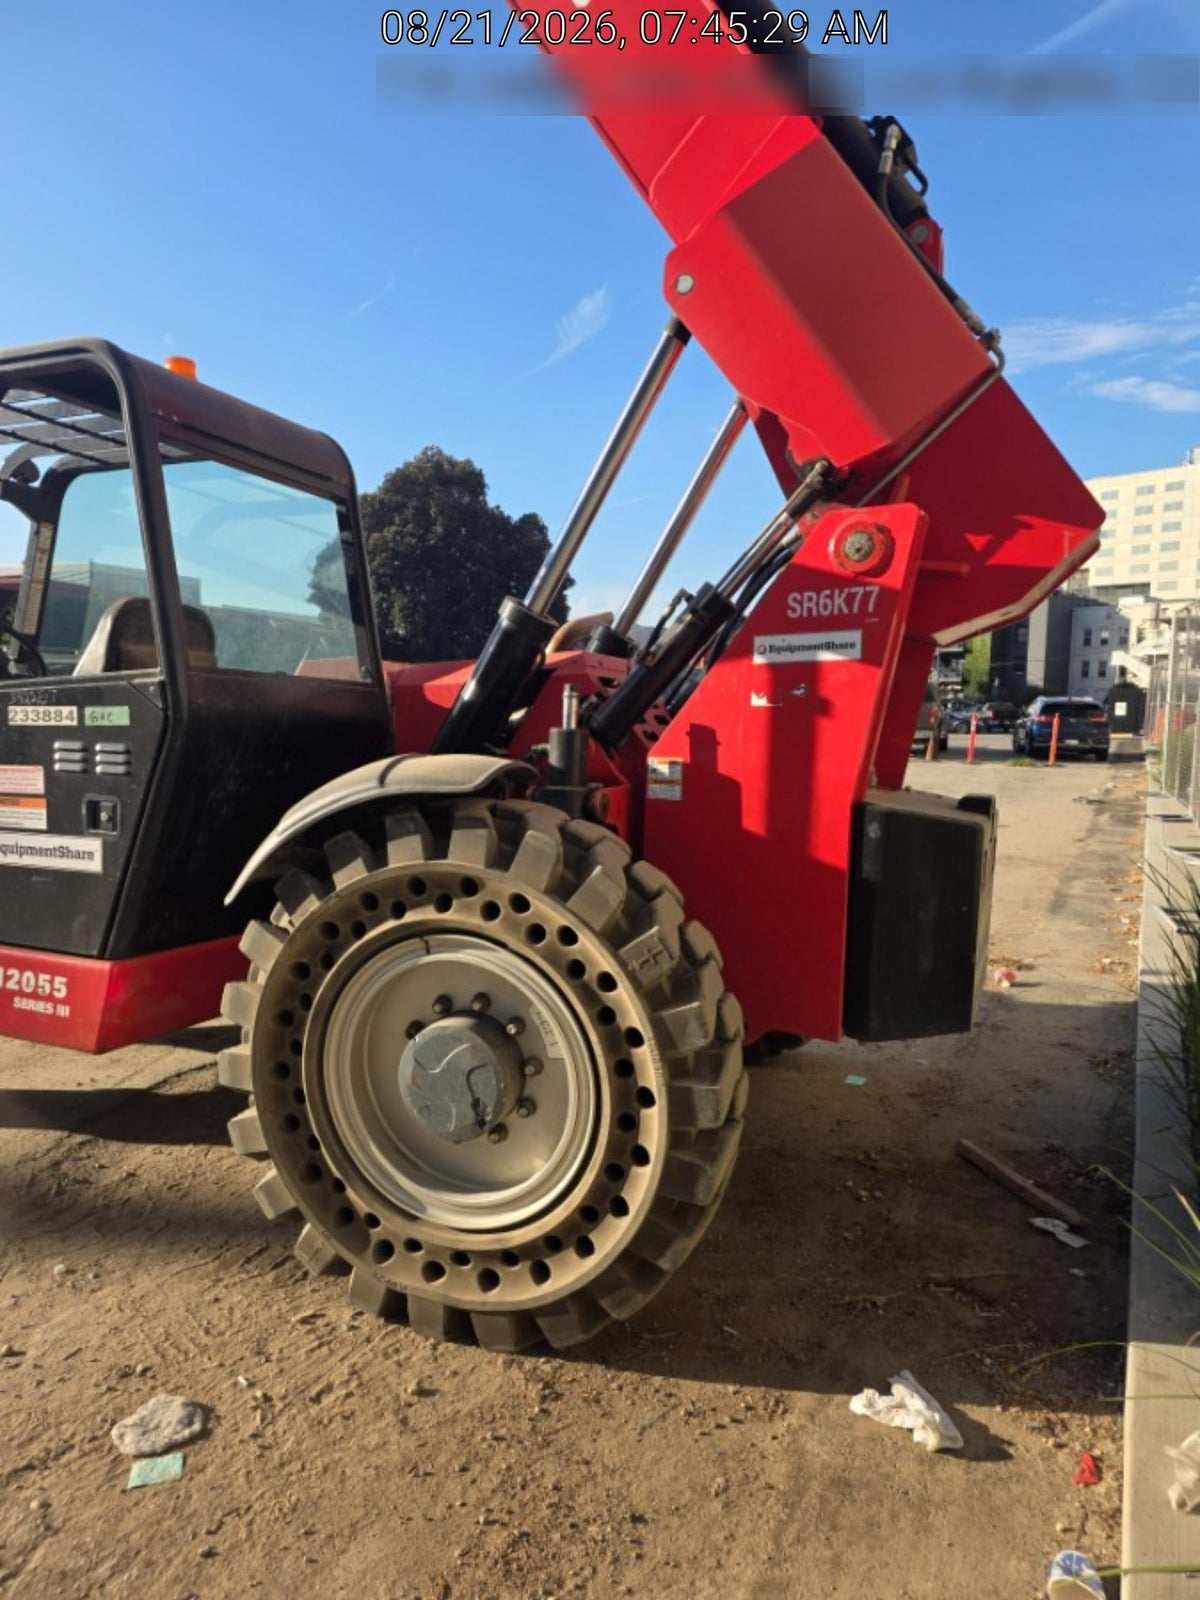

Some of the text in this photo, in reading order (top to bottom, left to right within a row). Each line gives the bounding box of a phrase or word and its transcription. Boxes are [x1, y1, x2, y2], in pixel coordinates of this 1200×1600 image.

[786, 585, 880, 619] SR6K77
[768, 641, 857, 655] EquipmentShare
[9, 708, 76, 723] 233884
[0, 841, 95, 861] quipmentShare
[13, 996, 70, 1018] SERIES III
